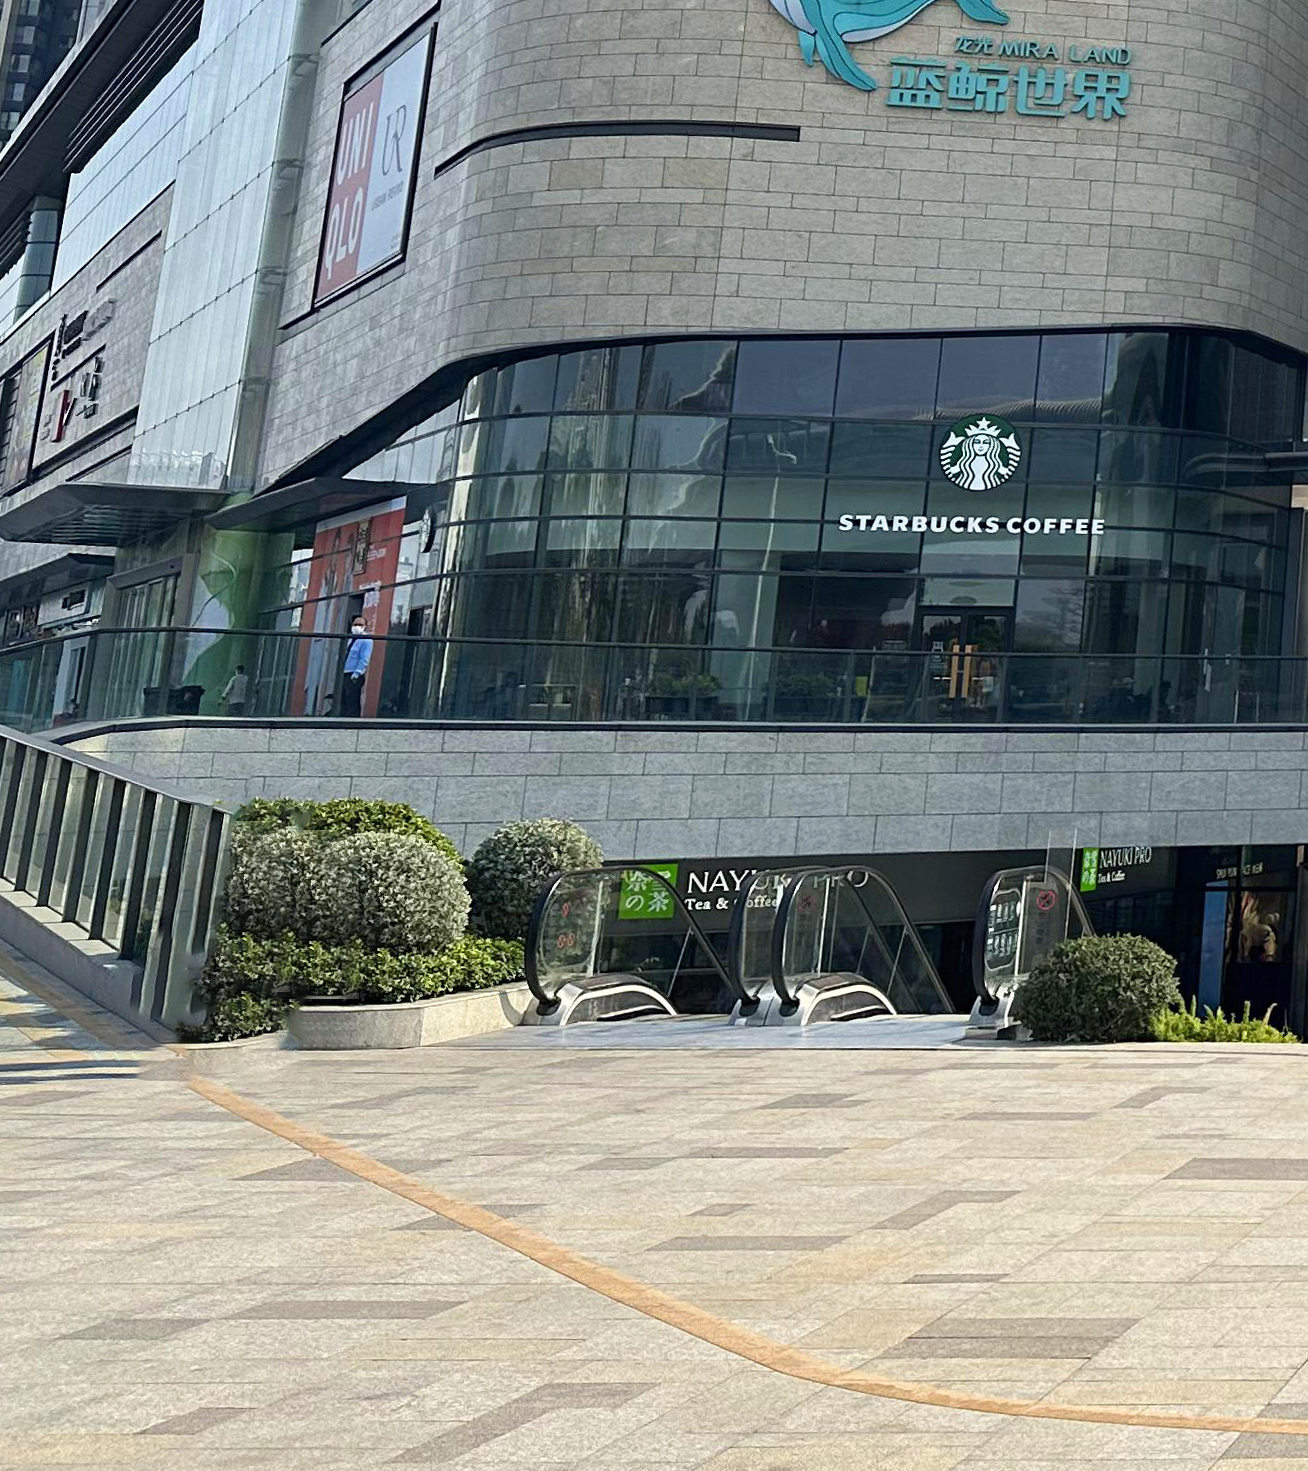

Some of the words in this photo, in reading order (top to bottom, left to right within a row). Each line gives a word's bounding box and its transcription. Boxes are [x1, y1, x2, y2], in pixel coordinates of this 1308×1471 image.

[998, 39, 1059, 60] MIRA
[1069, 44, 1132, 66] LAND
[885, 56, 1132, 121] 蓝鲸世界
[336, 102, 374, 186] UNI
[324, 186, 363, 280] QLO
[838, 514, 999, 534] STARBUCKS
[1006, 517, 1105, 535] COFFEE
[685, 899, 711, 910] Tea
[716, 898, 728, 910] &
